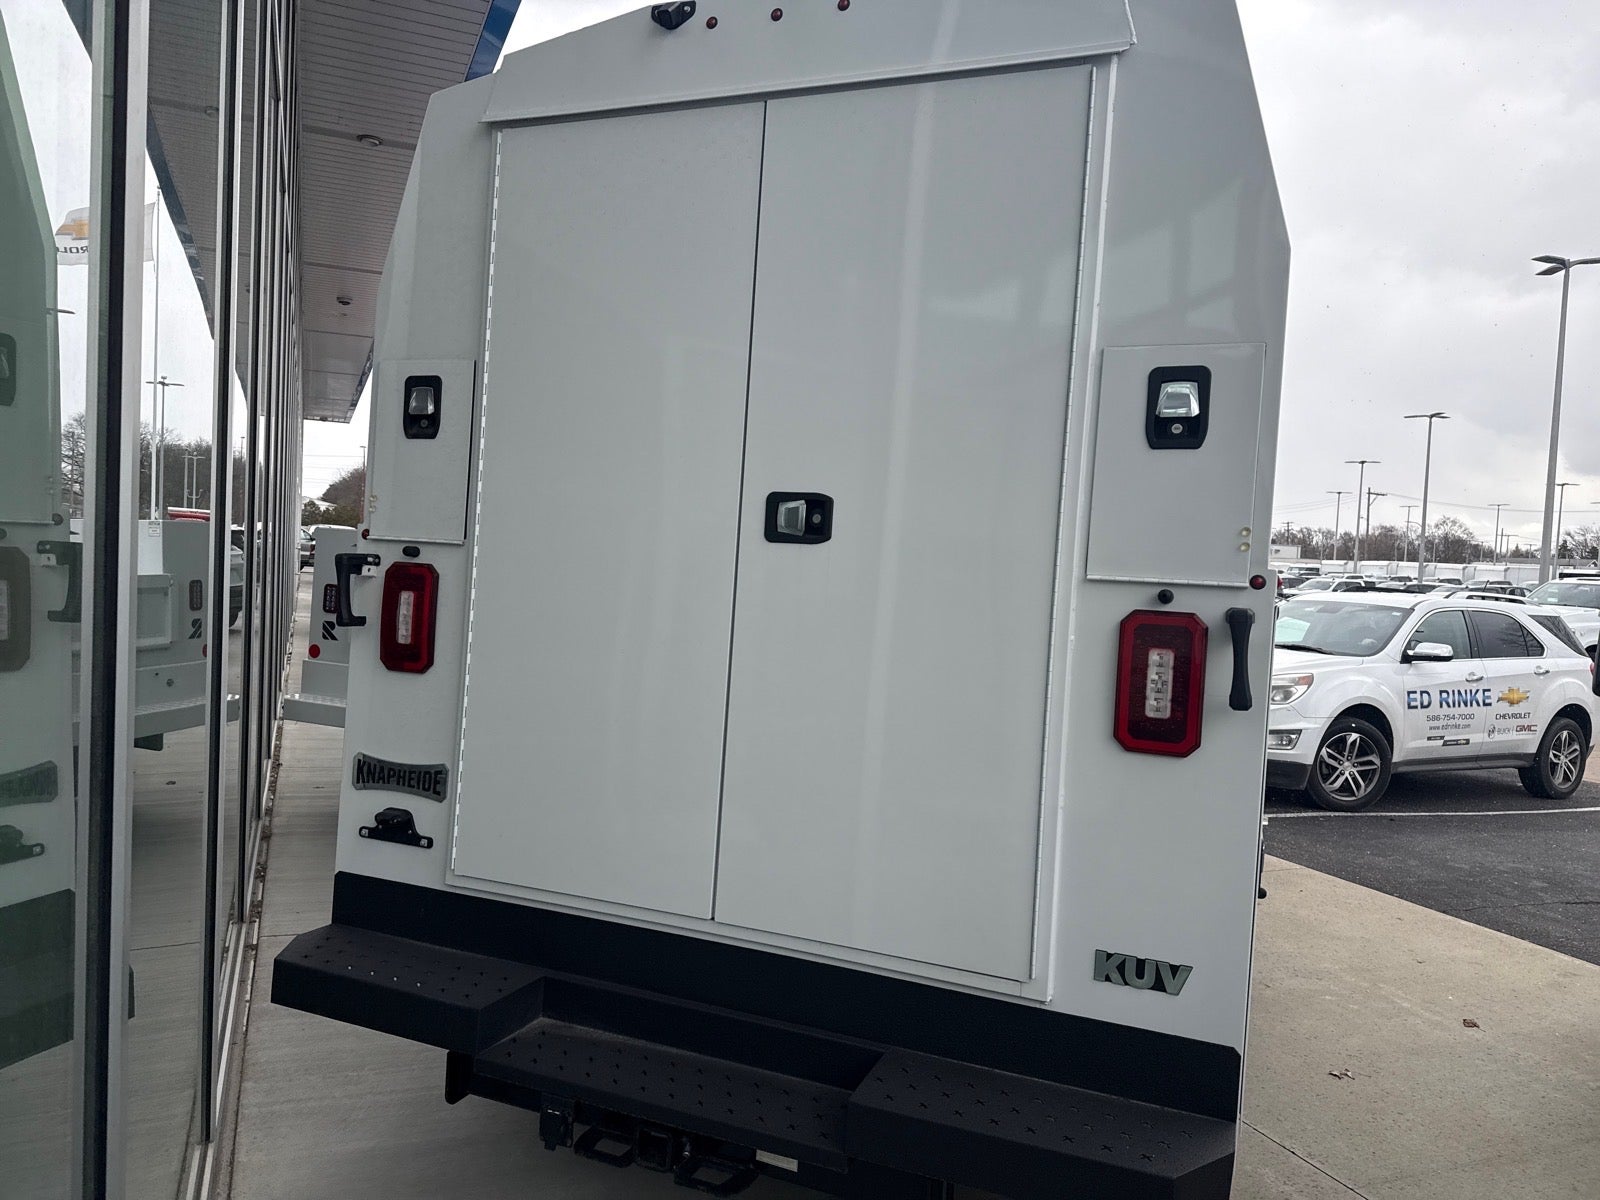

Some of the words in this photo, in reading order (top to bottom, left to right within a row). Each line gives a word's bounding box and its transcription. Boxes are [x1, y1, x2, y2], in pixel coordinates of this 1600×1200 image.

[1406, 690, 1432, 710] ED
[1440, 688, 1493, 709] RINKE
[1426, 713, 1475, 722] 586-754-7000
[1495, 711, 1531, 721] CHEVROLET
[1515, 724, 1538, 733] GMC
[356, 758, 443, 797] KNAPHEIDE
[1094, 949, 1194, 996] KUV
